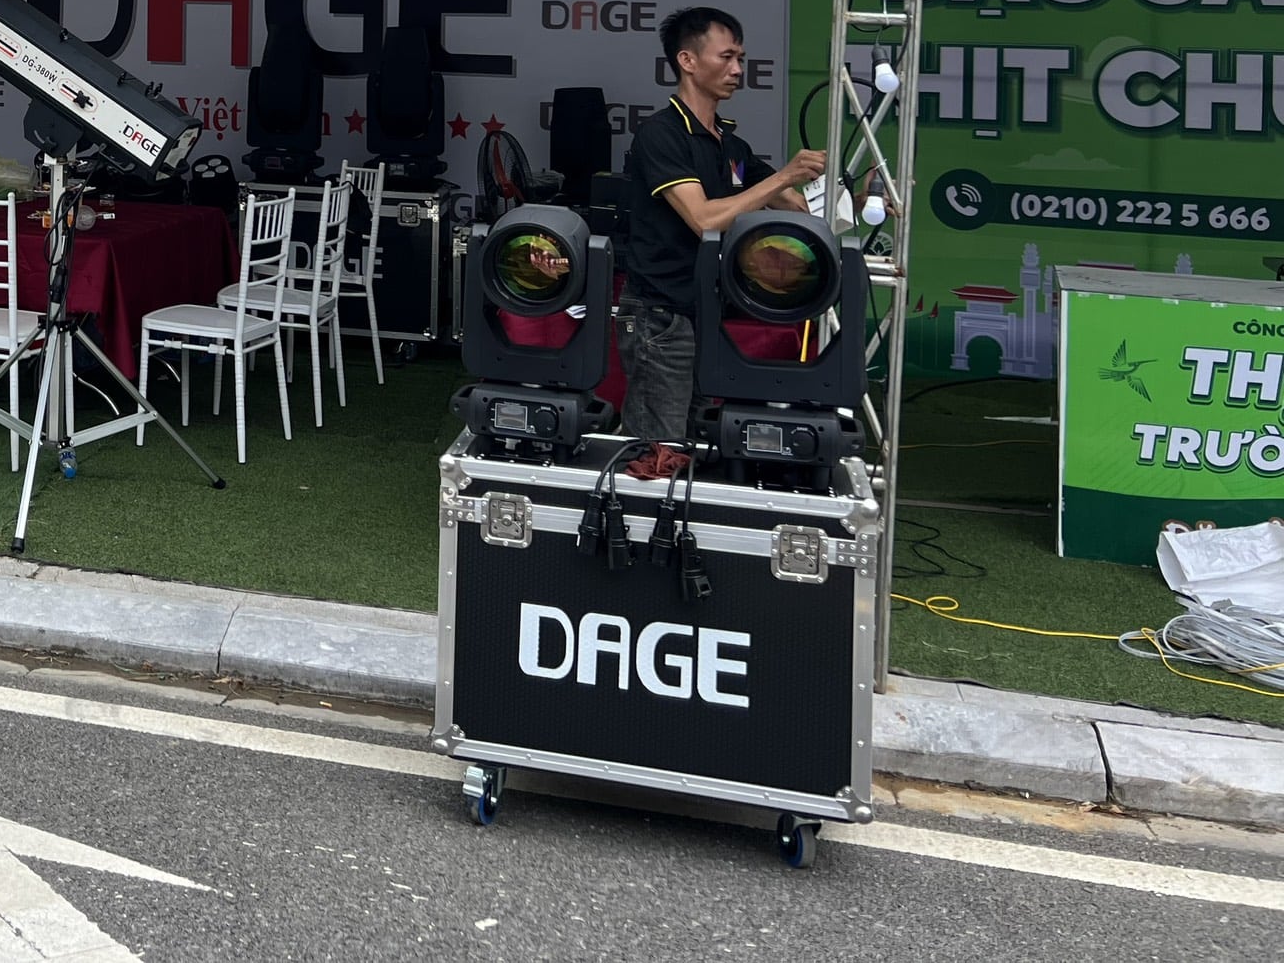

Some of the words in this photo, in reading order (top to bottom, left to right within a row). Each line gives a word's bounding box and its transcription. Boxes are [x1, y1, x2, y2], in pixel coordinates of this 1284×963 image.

[541, 0, 658, 33] DAGE
[22, 54, 58, 83] DG-380W
[834, 43, 1074, 137] THỊT
[1094, 46, 1284, 133] CH
[176, 97, 246, 142] Việt
[123, 125, 162, 158] DAGE
[1010, 191, 1108, 226] (0210)
[1116, 199, 1173, 227] 222
[1180, 203, 1200, 228] 5
[1208, 205, 1271, 232] 666
[1180, 345, 1284, 411] TH
[518, 602, 752, 709] DAGE
